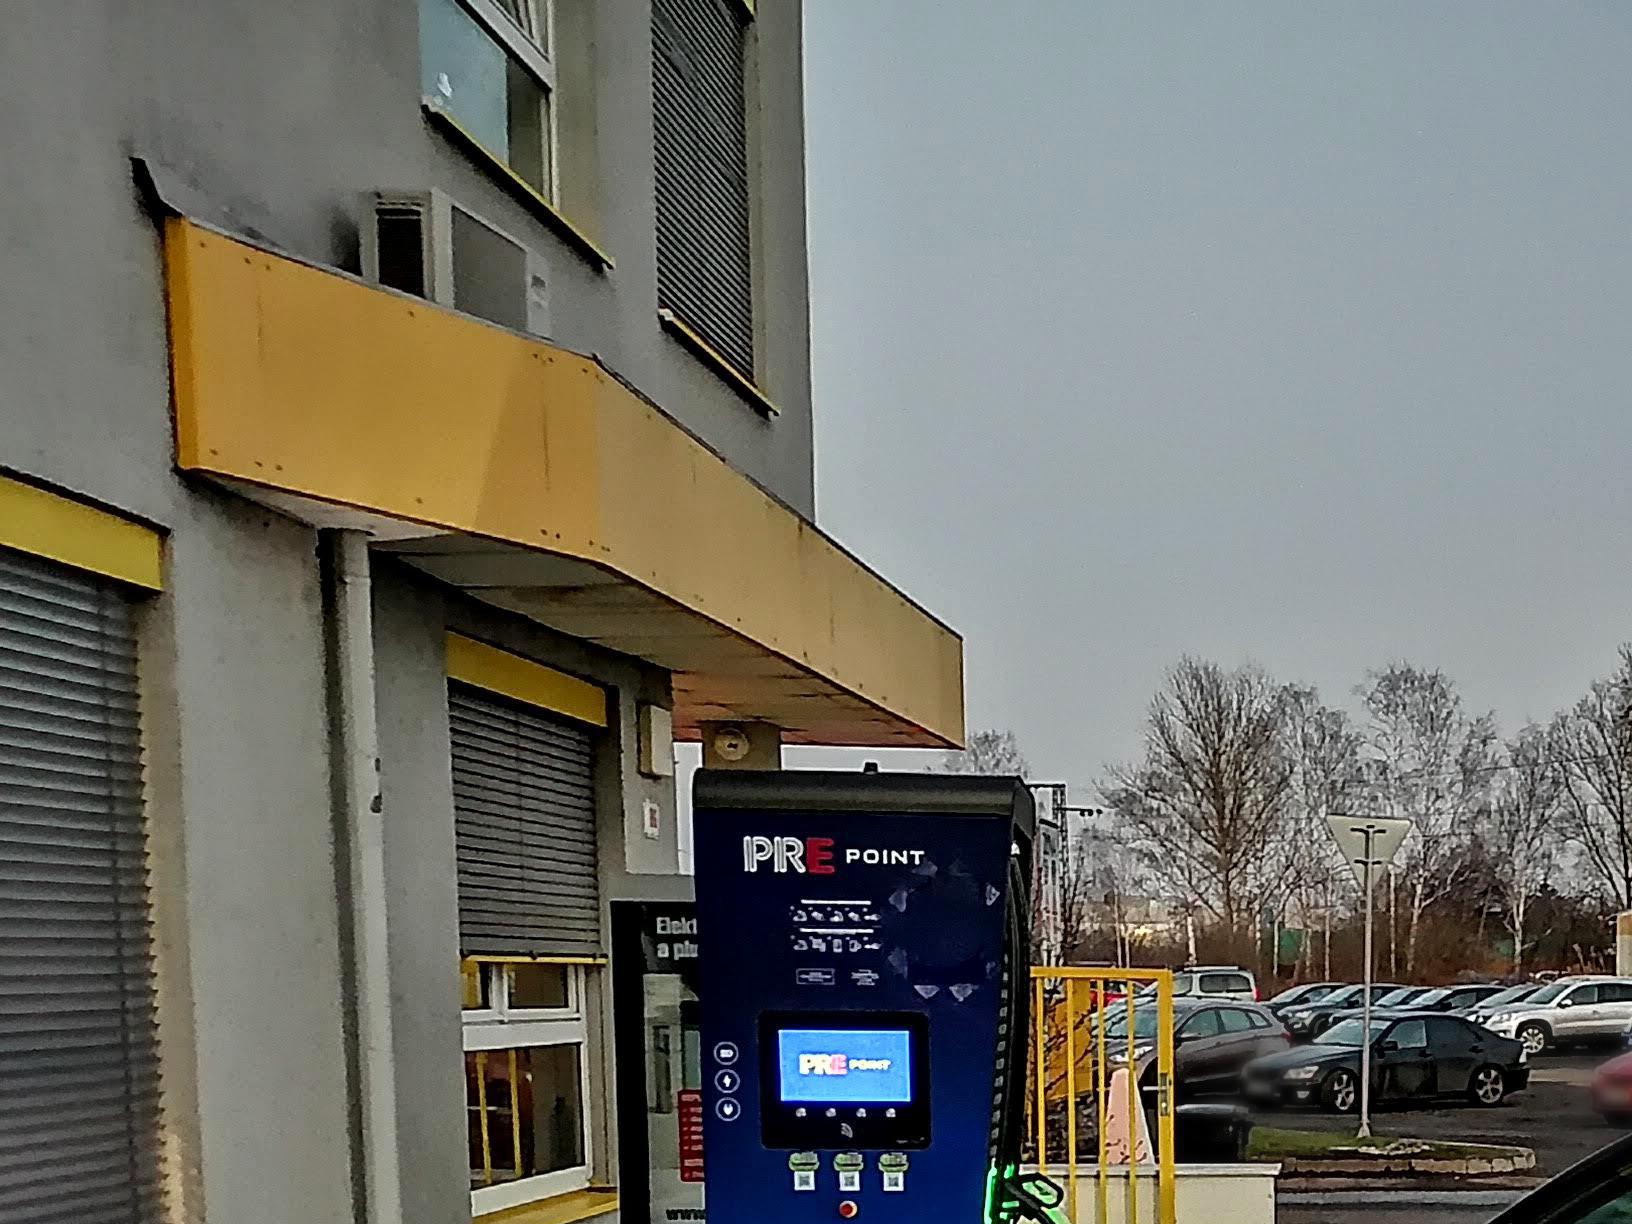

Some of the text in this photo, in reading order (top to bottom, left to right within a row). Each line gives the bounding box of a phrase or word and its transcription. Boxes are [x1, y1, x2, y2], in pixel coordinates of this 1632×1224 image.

[743, 836, 925, 873] PRE POINT
[657, 943, 669, 957] a
[799, 1053, 891, 1075] PRE POINT
